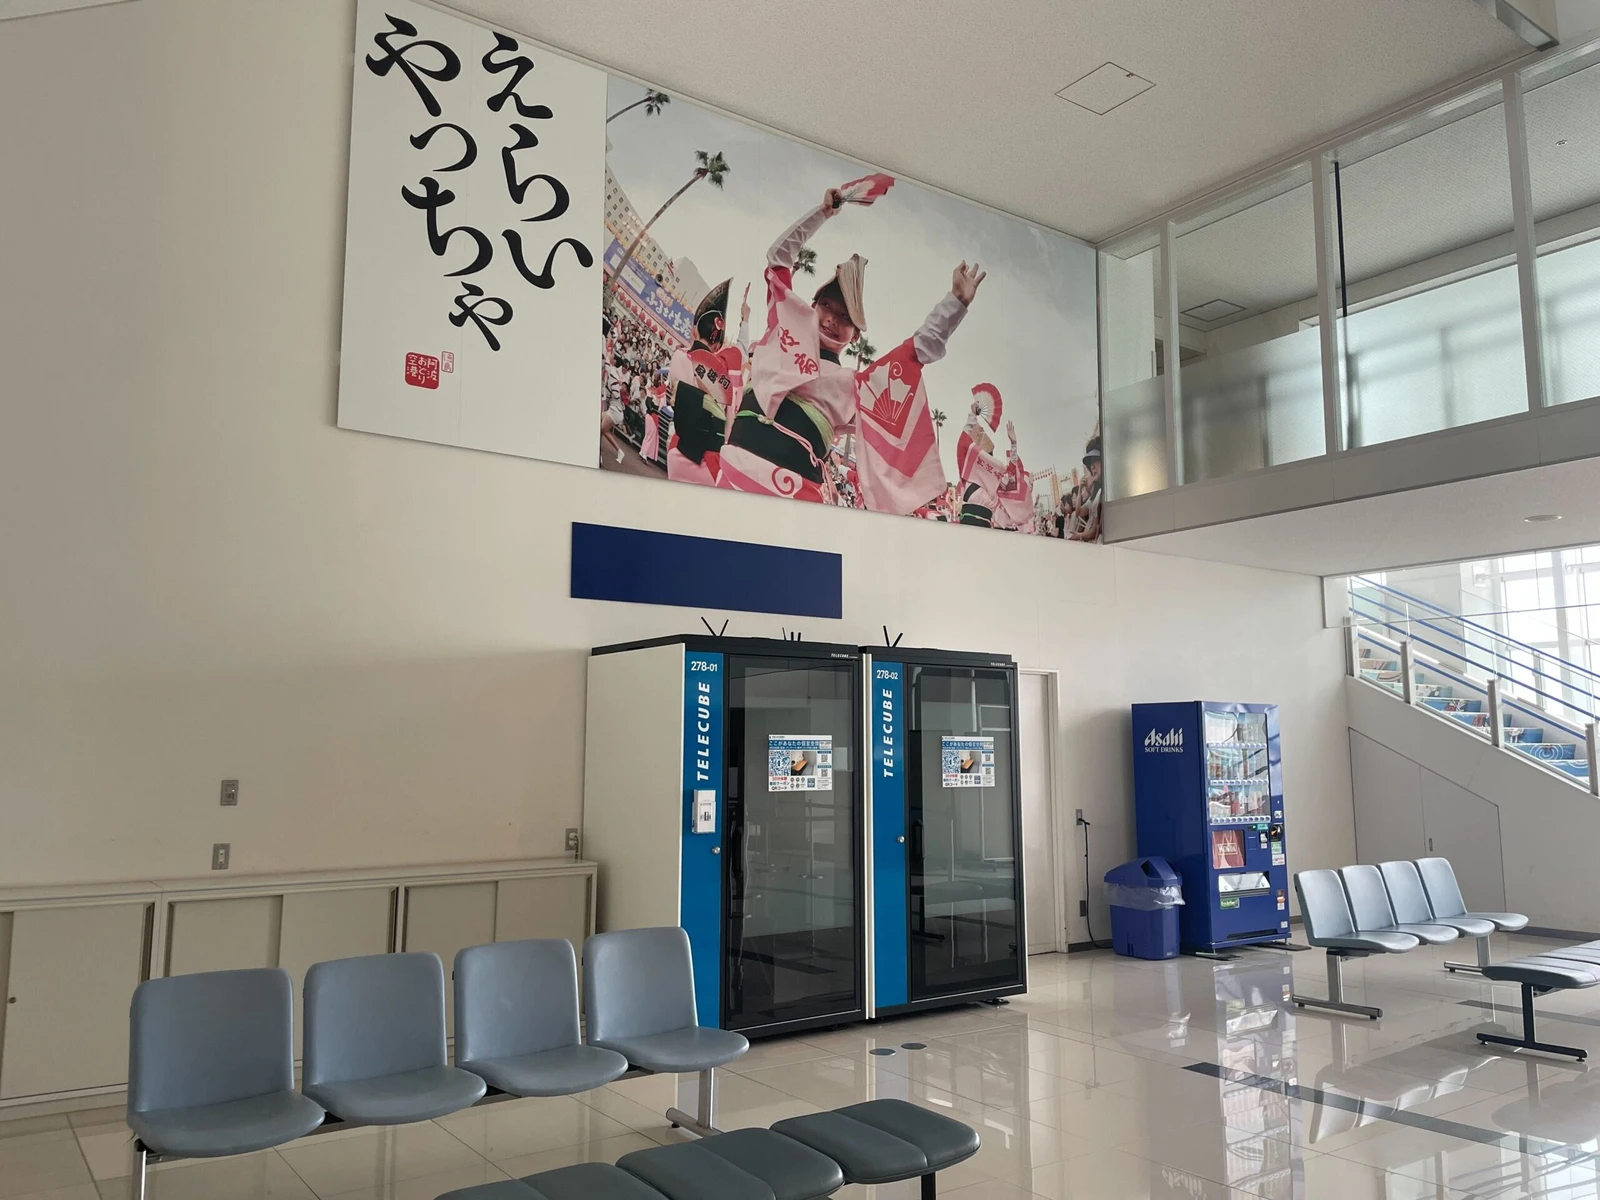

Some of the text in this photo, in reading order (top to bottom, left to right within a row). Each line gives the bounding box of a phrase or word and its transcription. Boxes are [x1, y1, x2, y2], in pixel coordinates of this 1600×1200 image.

[481, 29, 593, 290] えらい
[365, 12, 514, 352] やっちゃ
[407, 354, 418, 377] 空港
[418, 356, 428, 384] おどり
[427, 358, 438, 382] 阿波
[690, 661, 718, 672] 278-01
[876, 670, 899, 680] 278-02
[696, 681, 710, 781] TELECUBE
[882, 688, 894, 778] TELECUBE
[1144, 727, 1184, 746] Asahi
